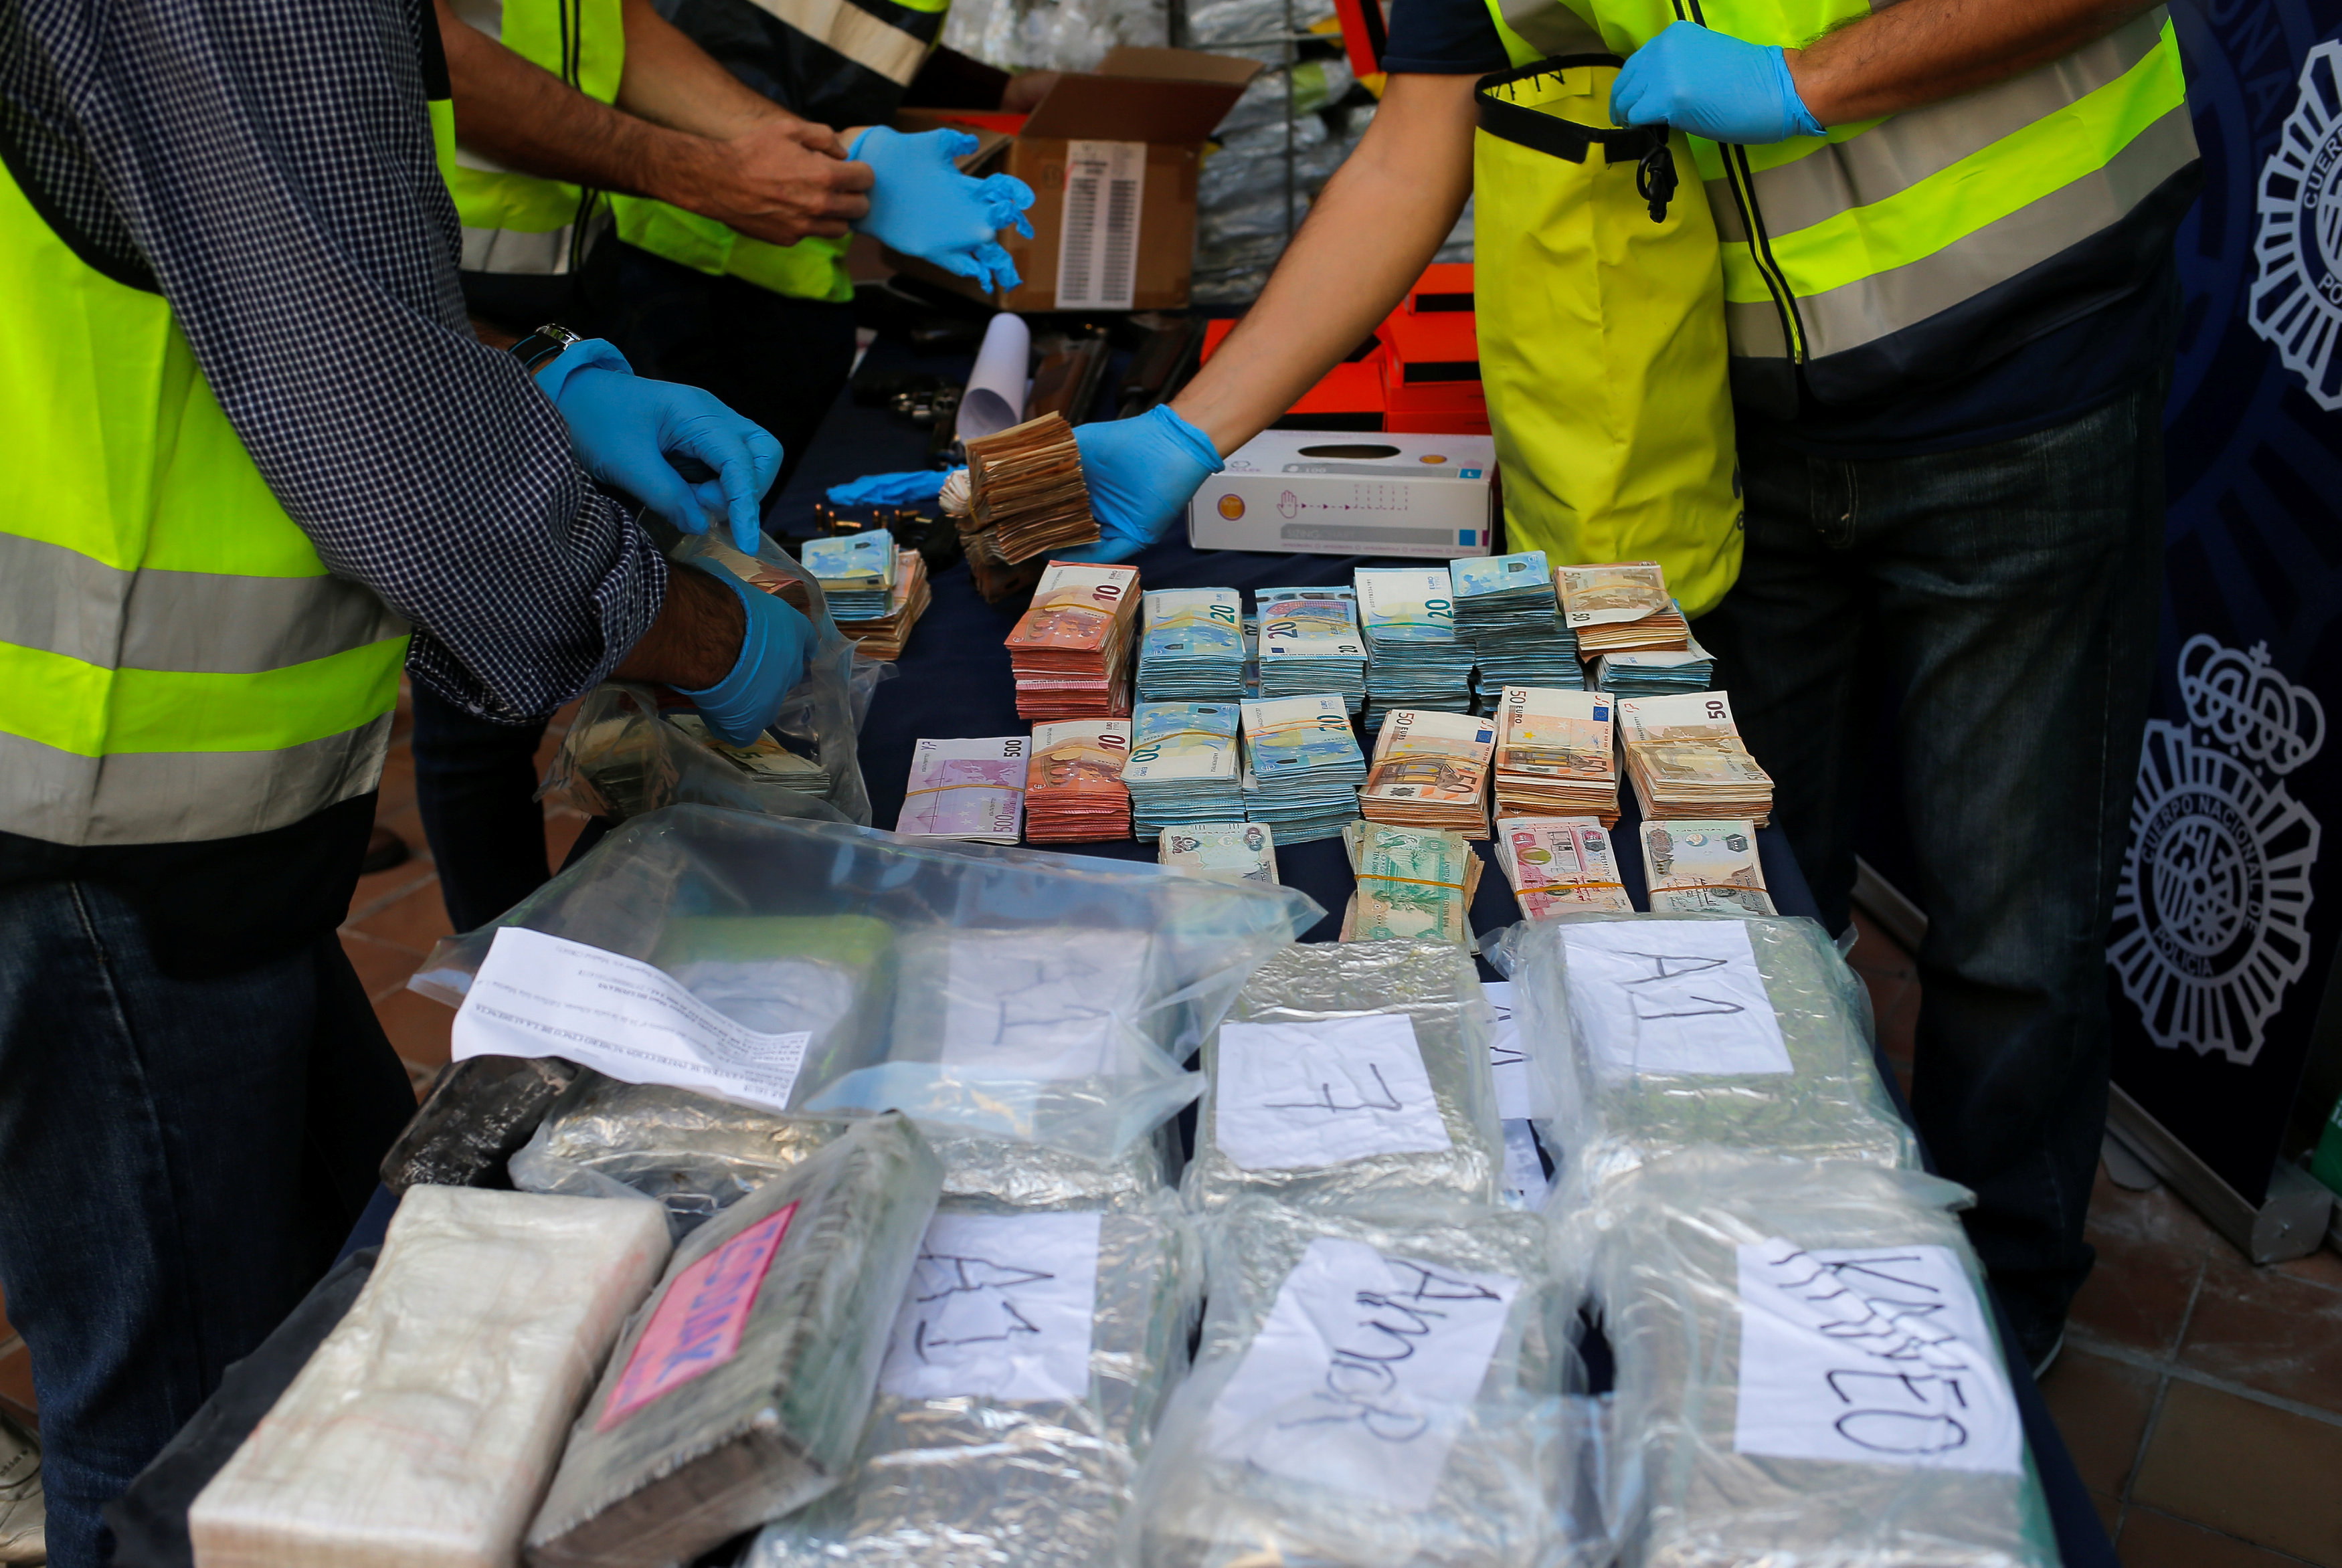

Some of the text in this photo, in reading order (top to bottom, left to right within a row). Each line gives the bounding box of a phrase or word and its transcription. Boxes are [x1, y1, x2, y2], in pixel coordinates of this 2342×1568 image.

[1091, 585, 1121, 602] 10
[1210, 604, 1235, 623] 20
[1425, 599, 1453, 619] 20
[1572, 613, 1591, 622] 50
[1267, 621, 1299, 640] 20
[1338, 645, 1358, 654] 20
[1510, 690, 1527, 704] 50
[1515, 706, 1524, 724] EURO
[1705, 700, 1726, 719] 50
[1316, 714, 1348, 732] 20
[1396, 712, 1415, 726] 50
[1097, 734, 1126, 751] 10
[1397, 726, 1409, 741] EURO
[1002, 739, 1022, 758] 500
[1131, 744, 1162, 763] 20
[1743, 772, 1767, 781] 50
[993, 814, 1015, 832] 500
[2141, 794, 2262, 933] CUERPO NACIONAL DE
[2152, 925, 2214, 979] POLICIA
